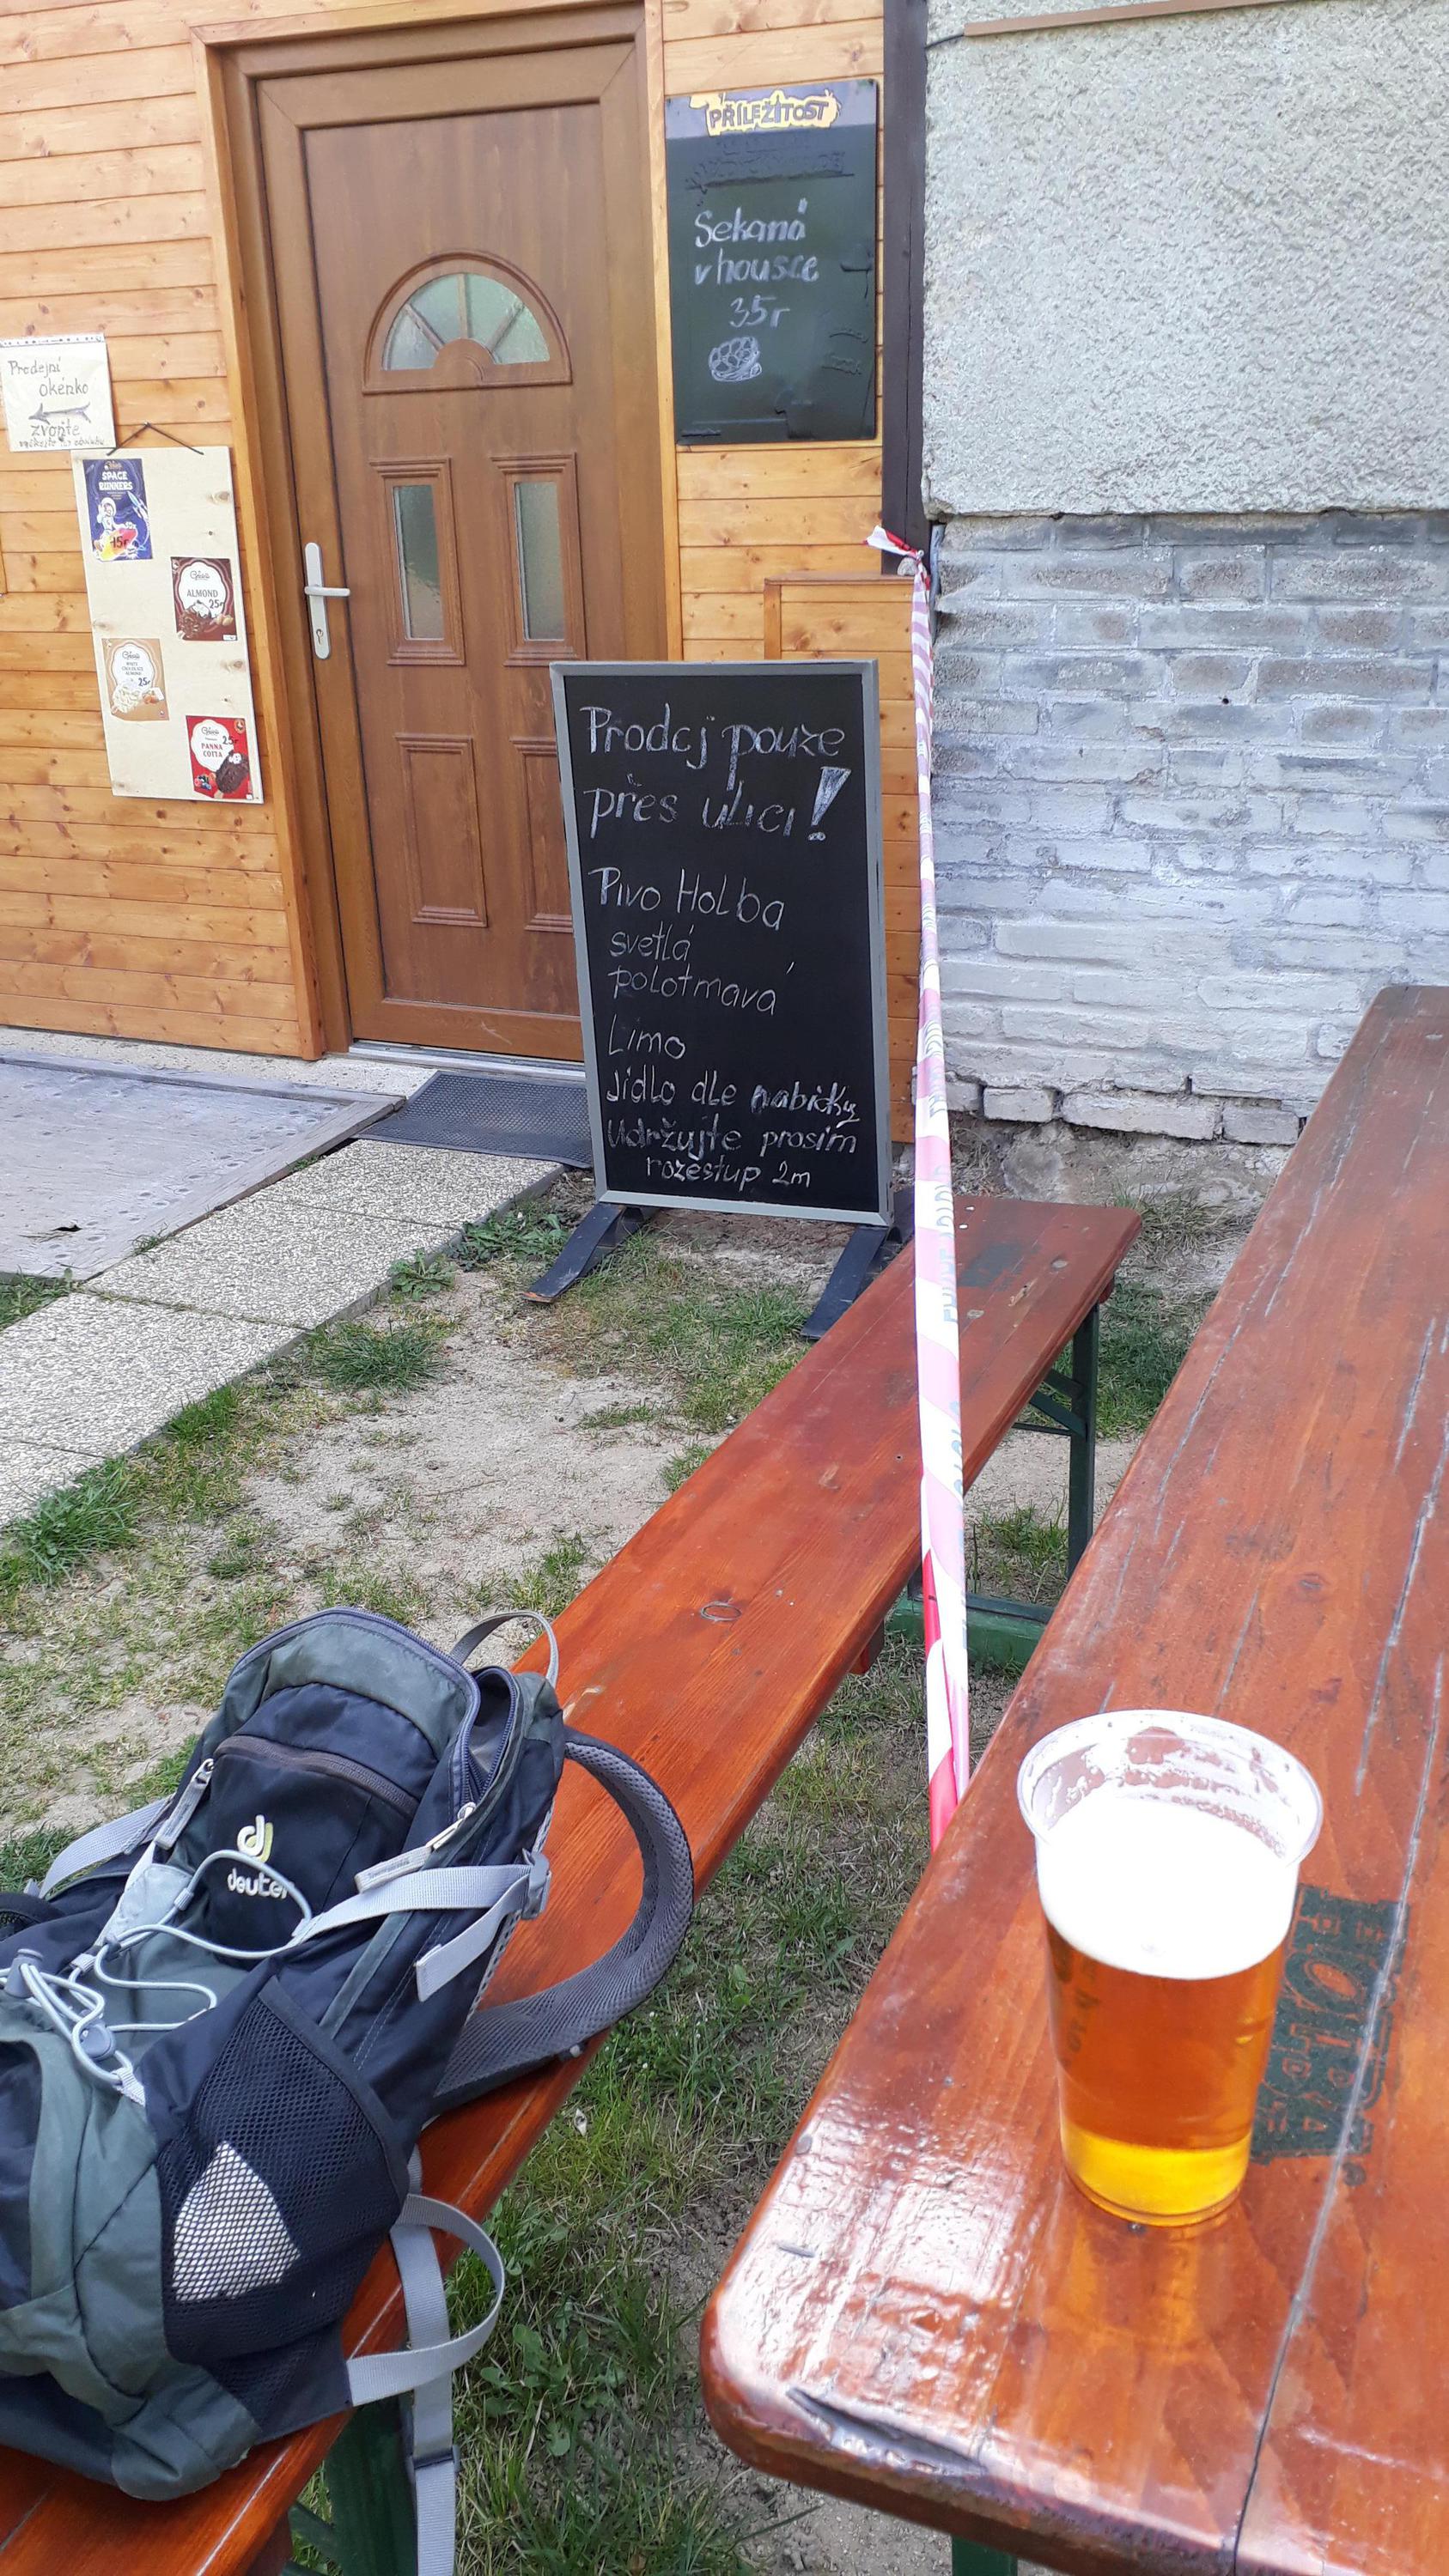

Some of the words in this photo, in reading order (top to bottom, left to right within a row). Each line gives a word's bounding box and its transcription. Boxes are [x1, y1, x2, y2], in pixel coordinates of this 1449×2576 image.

[694, 197, 808, 248] Sekaná
[98, 481, 133, 491] RUNNERS
[101, 471, 129, 481] SPACE
[186, 589, 219, 598] ALMOND
[580, 702, 715, 769] Prodej
[721, 723, 846, 792] pouze
[588, 866, 661, 911] Pivo
[608, 1013, 686, 1060] Limo
[646, 1155, 763, 1192] rozestup
[771, 1160, 812, 1188] 2m
[227, 1867, 295, 1900] deuter
